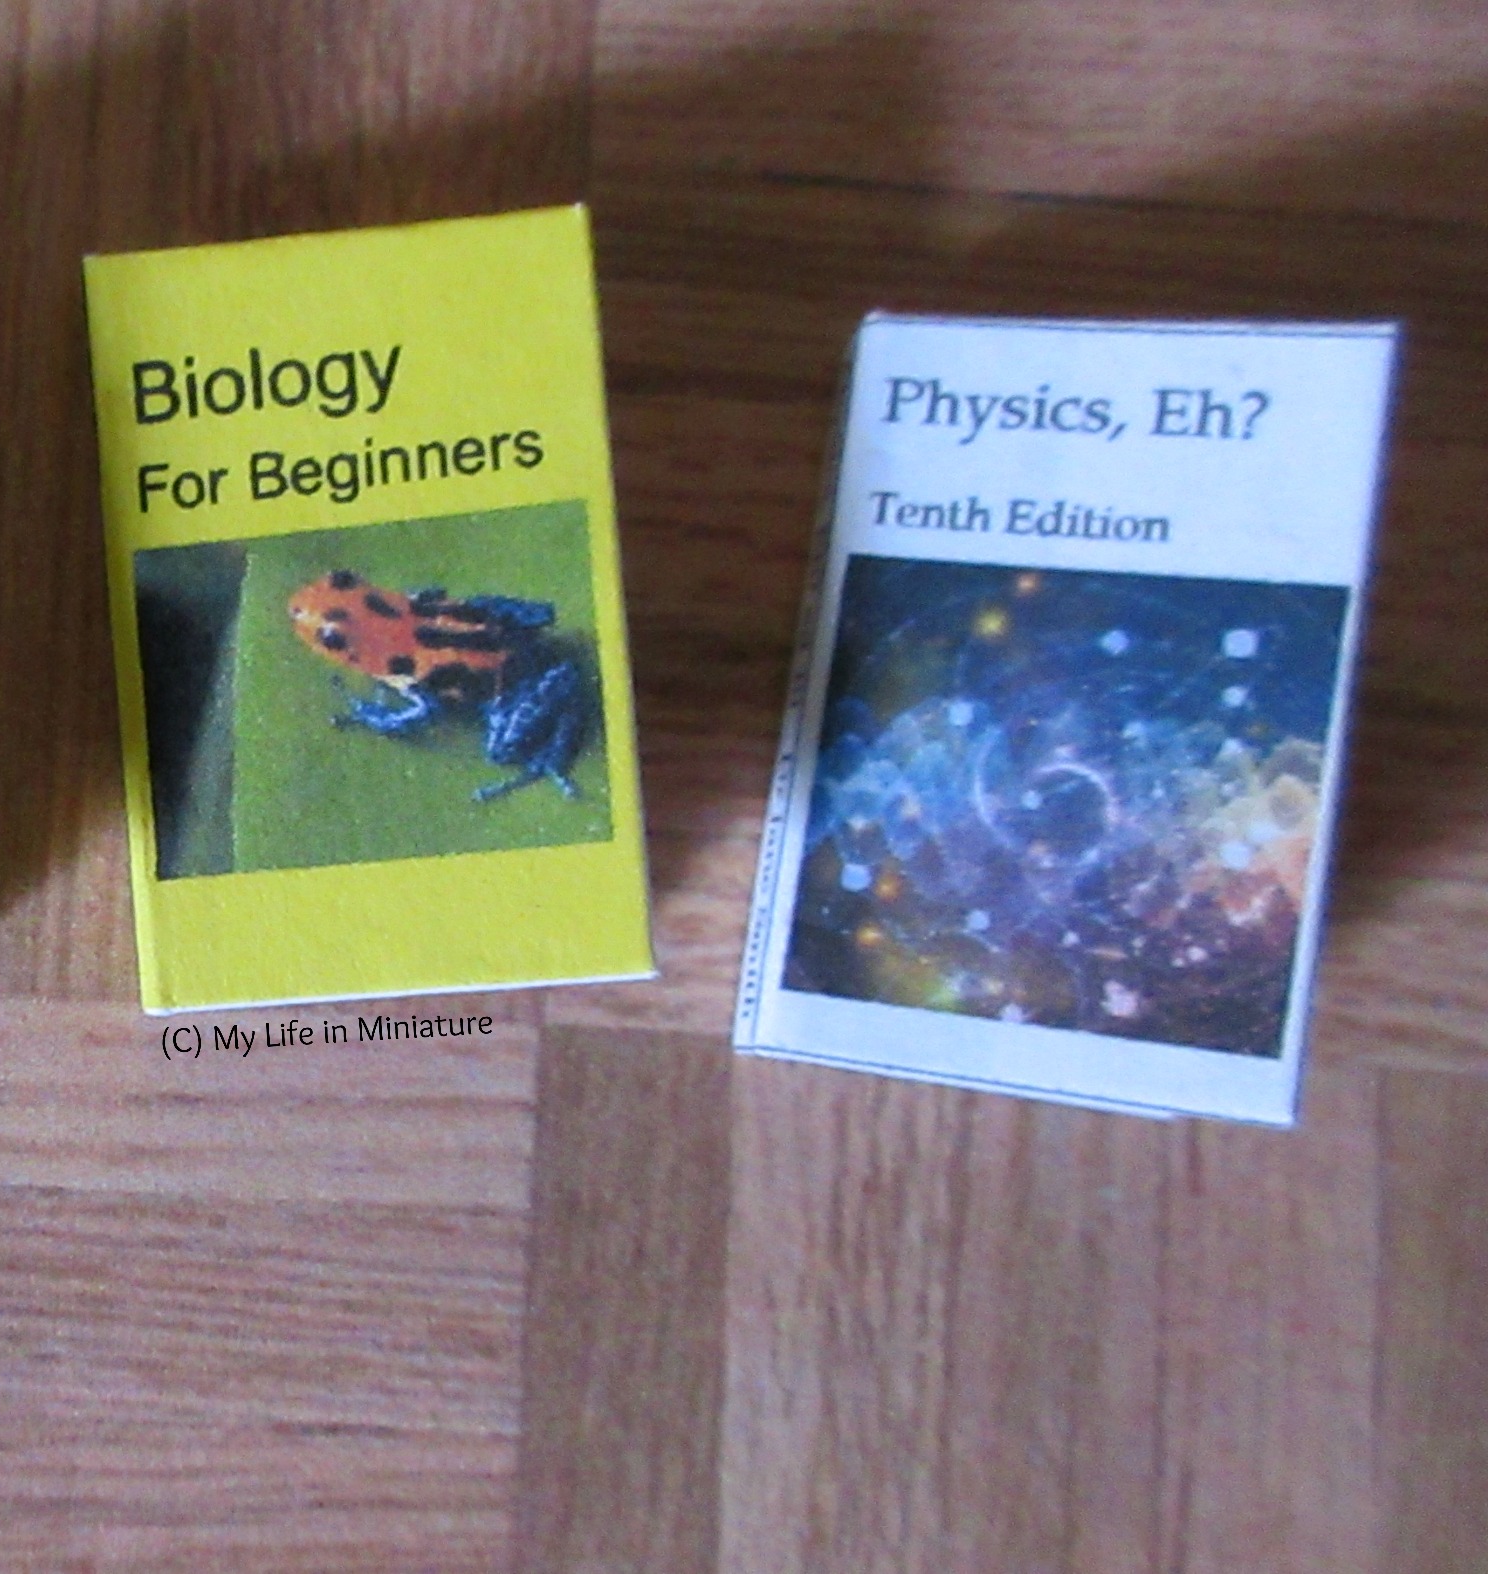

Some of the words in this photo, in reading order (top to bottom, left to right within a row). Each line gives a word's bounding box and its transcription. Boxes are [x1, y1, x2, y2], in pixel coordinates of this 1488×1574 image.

[132, 345, 402, 426] Biology
[882, 377, 1128, 445] Physics,
[1150, 389, 1270, 440] Eh?
[137, 465, 228, 513] For
[249, 427, 544, 503] Beginners
[869, 491, 991, 534] Tenth
[1005, 498, 1170, 543] Edition
